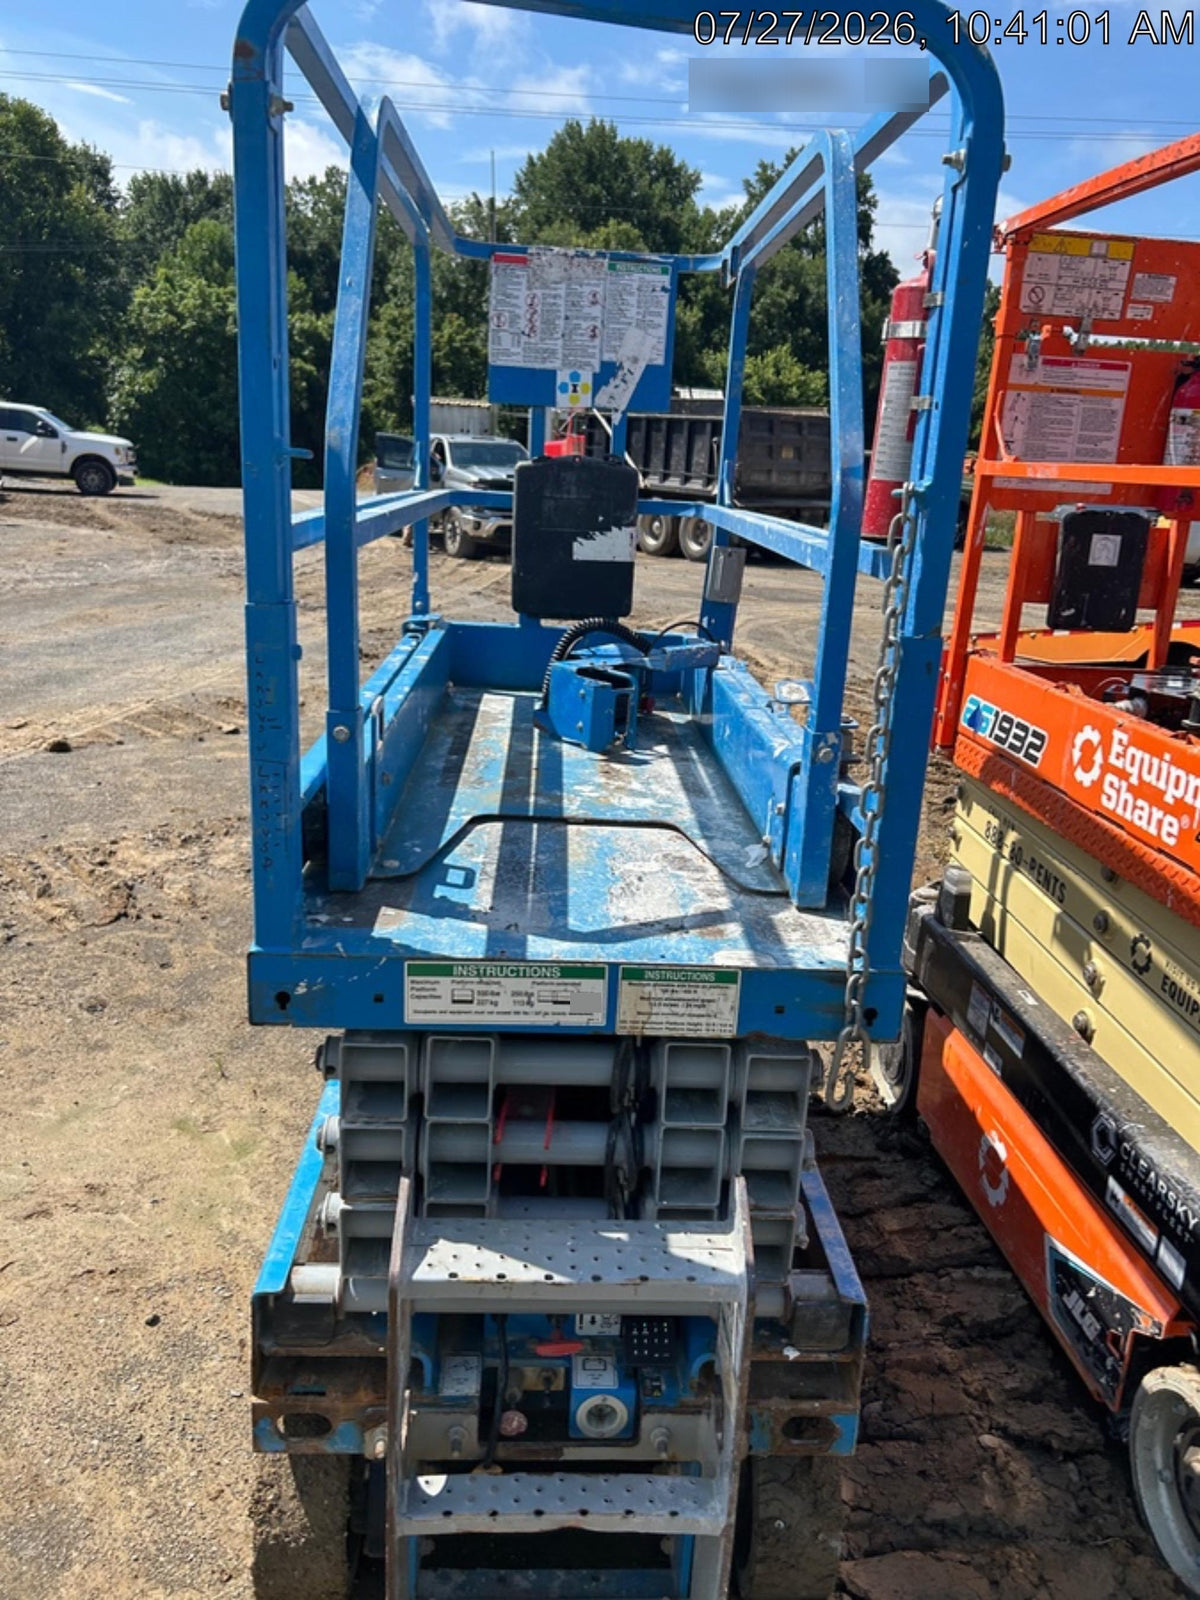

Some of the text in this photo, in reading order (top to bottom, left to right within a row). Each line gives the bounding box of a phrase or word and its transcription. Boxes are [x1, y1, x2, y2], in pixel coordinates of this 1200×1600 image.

[452, 964, 562, 978] INSTRUCTIONS
[644, 970, 716, 982] INSTRUCTIONS
[1161, 974, 1200, 1023] EQUIP
[1120, 1163, 1154, 1202] SMART
[1120, 1141, 1199, 1230] CLEARSKY
[1062, 1291, 1102, 1341] JLG
